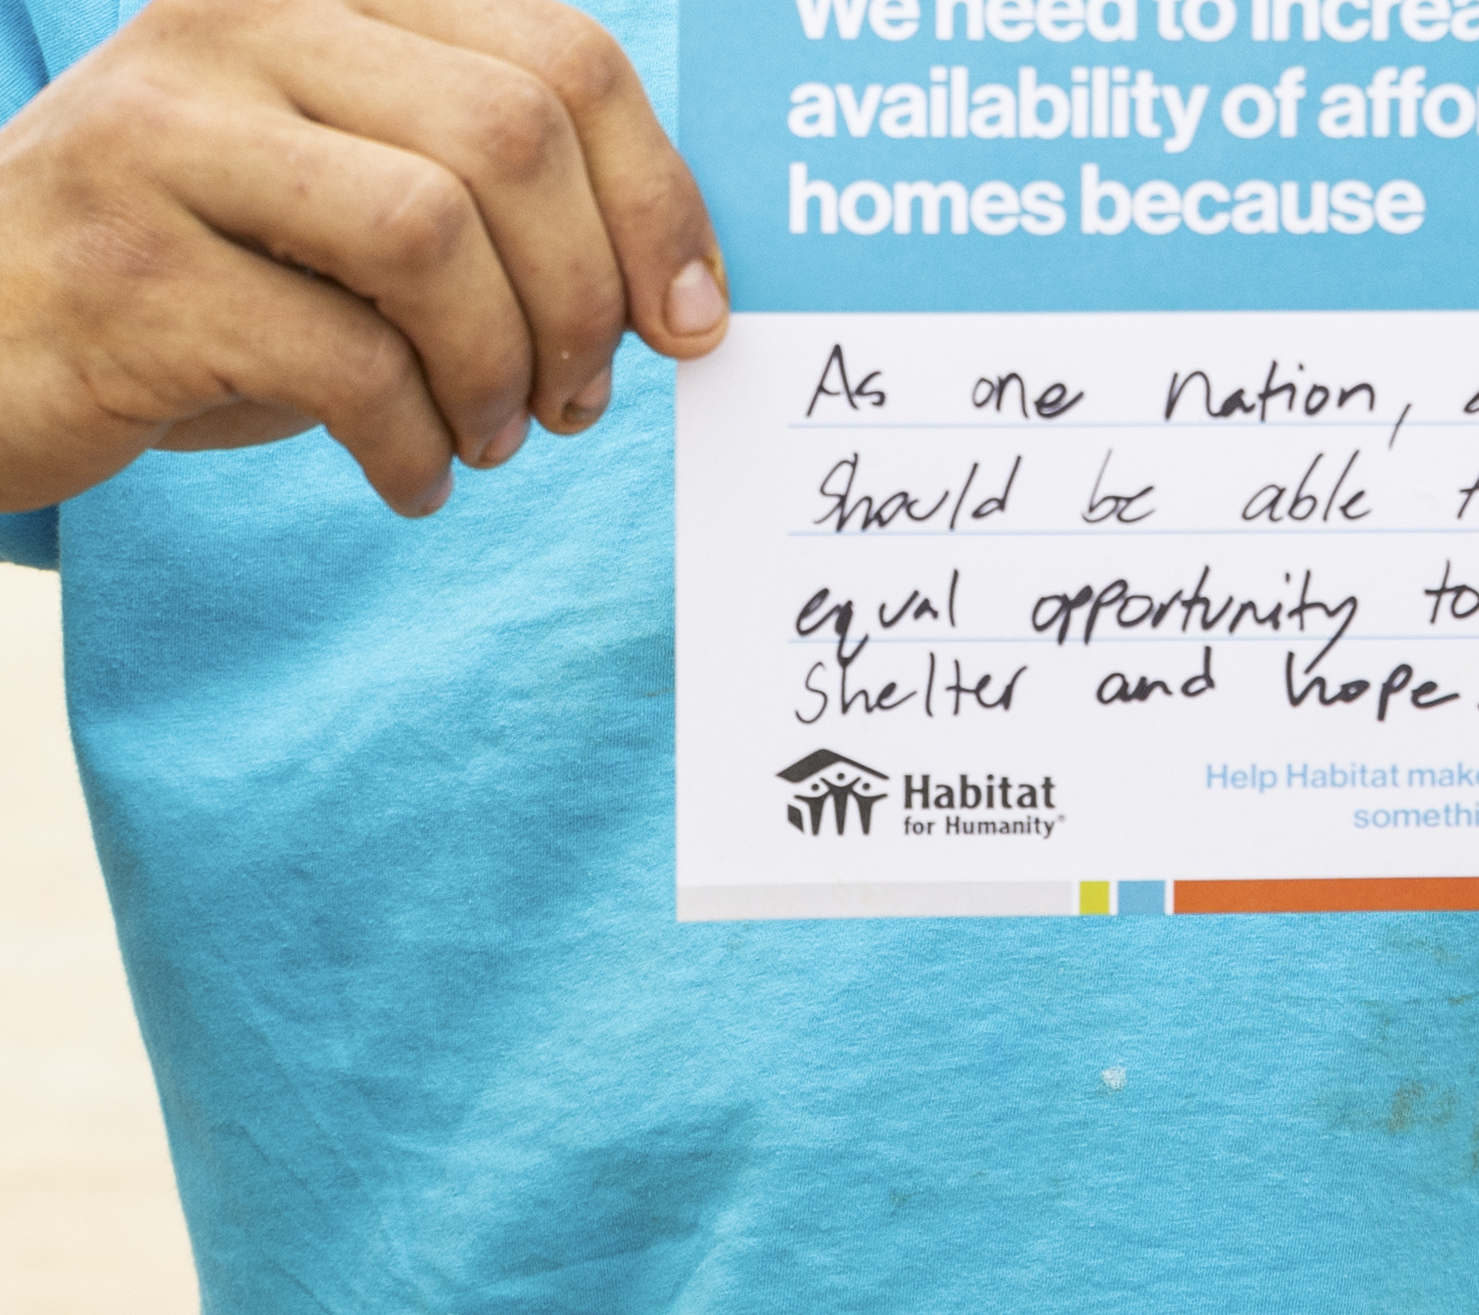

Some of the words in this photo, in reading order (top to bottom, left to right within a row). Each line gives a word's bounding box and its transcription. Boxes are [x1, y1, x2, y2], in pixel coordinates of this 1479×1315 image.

[787, 66, 1210, 153] availability
[1221, 66, 1306, 139] of
[789, 162, 1066, 236] homes
[1081, 163, 1425, 235] because
[806, 343, 886, 417] As
[973, 372, 1085, 420] one
[1081, 448, 1156, 525] be
[1241, 449, 1369, 523] able
[795, 567, 960, 660] equal
[1031, 564, 1359, 675] opportunity
[1095, 645, 1216, 705] and
[904, 773, 1055, 810] Habitat
[1206, 764, 1278, 794] Help
[1286, 762, 1399, 788] Habitat
[904, 816, 935, 835] for
